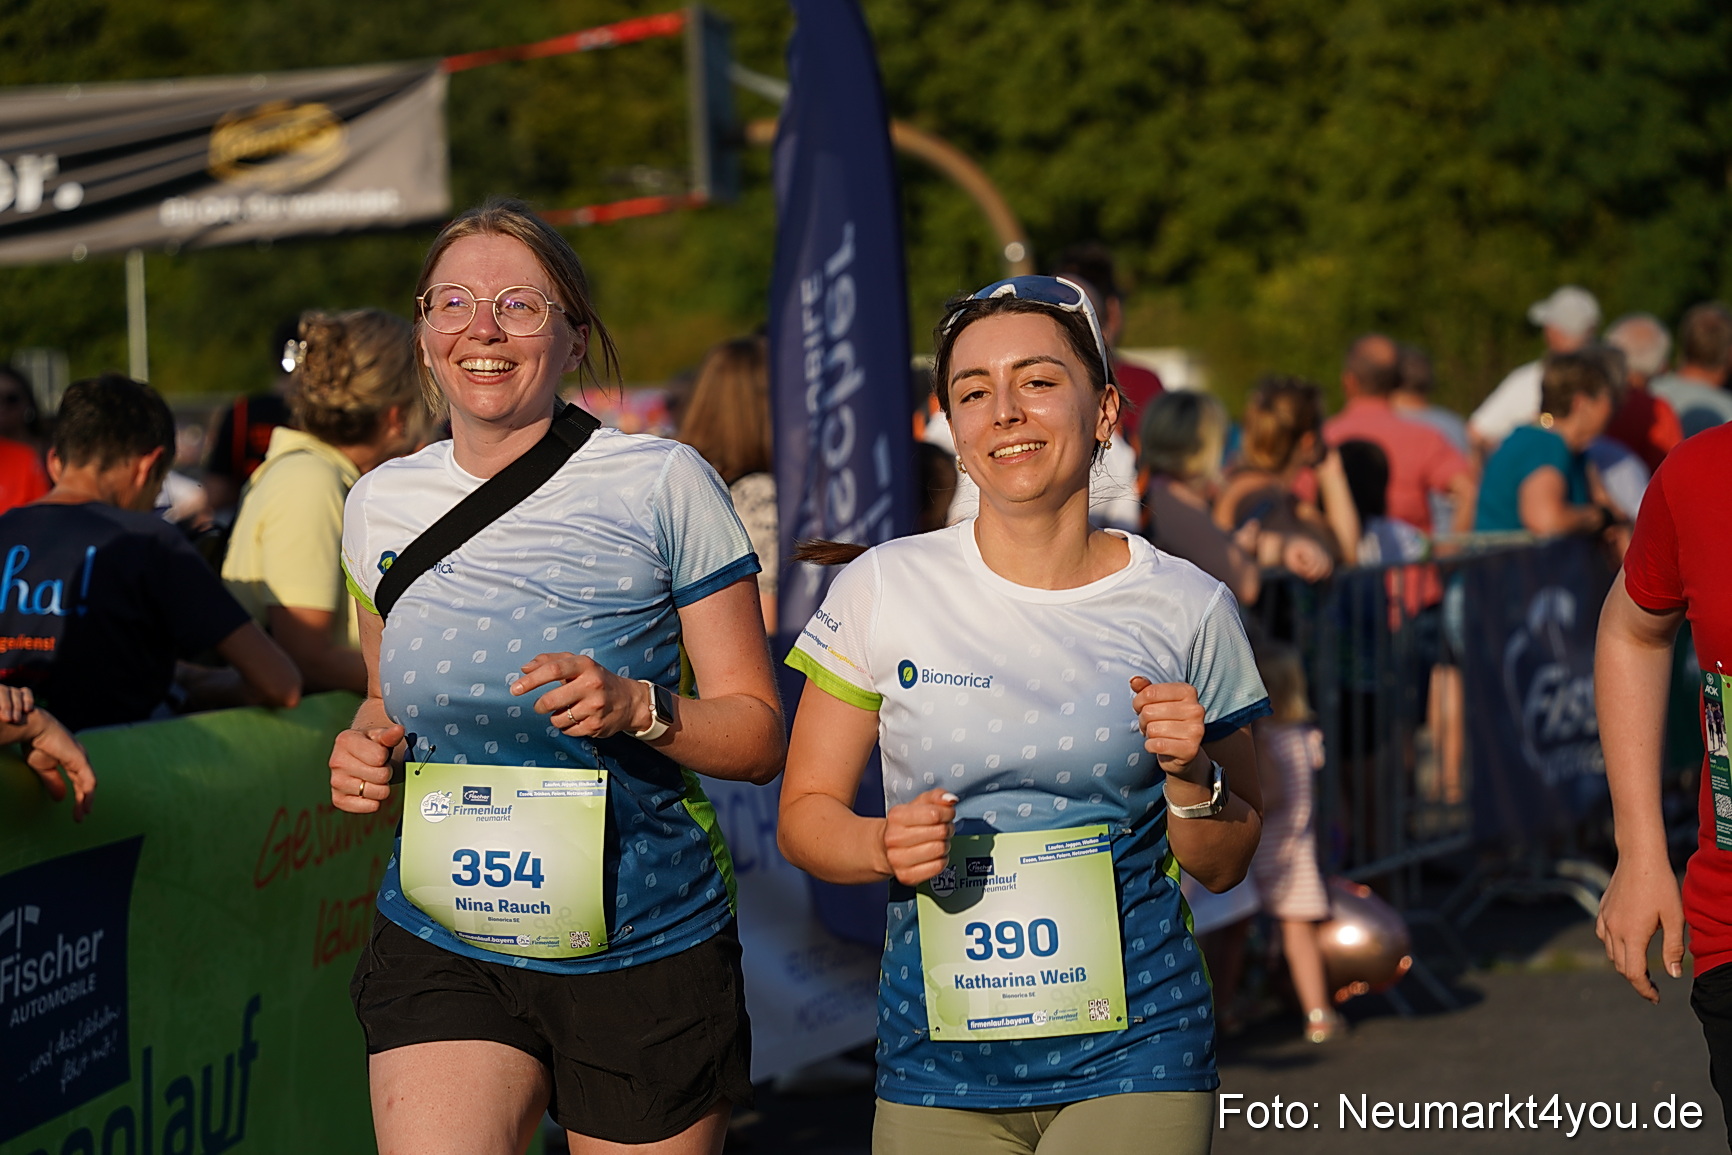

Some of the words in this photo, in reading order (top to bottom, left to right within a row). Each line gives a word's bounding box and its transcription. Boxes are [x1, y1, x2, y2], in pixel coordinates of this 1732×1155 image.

[0, 544, 97, 617] ha!
[1704, 684, 1719, 697] AOK
[453, 805, 512, 816] Firmenlauf
[452, 848, 544, 888] 354
[960, 872, 1017, 888] Firmenlauf
[982, 884, 1017, 893] neumarkt
[455, 897, 494, 912] Nina
[498, 899, 550, 914] Rauch
[965, 918, 1058, 960] 390
[0, 928, 104, 1004] Fischer
[954, 972, 1036, 990] Katharina
[1040, 966, 1087, 985] Weiß
[9, 972, 97, 1029] AUTOMOBILE
[970, 1016, 1031, 1030] firmenlauf.bayern
